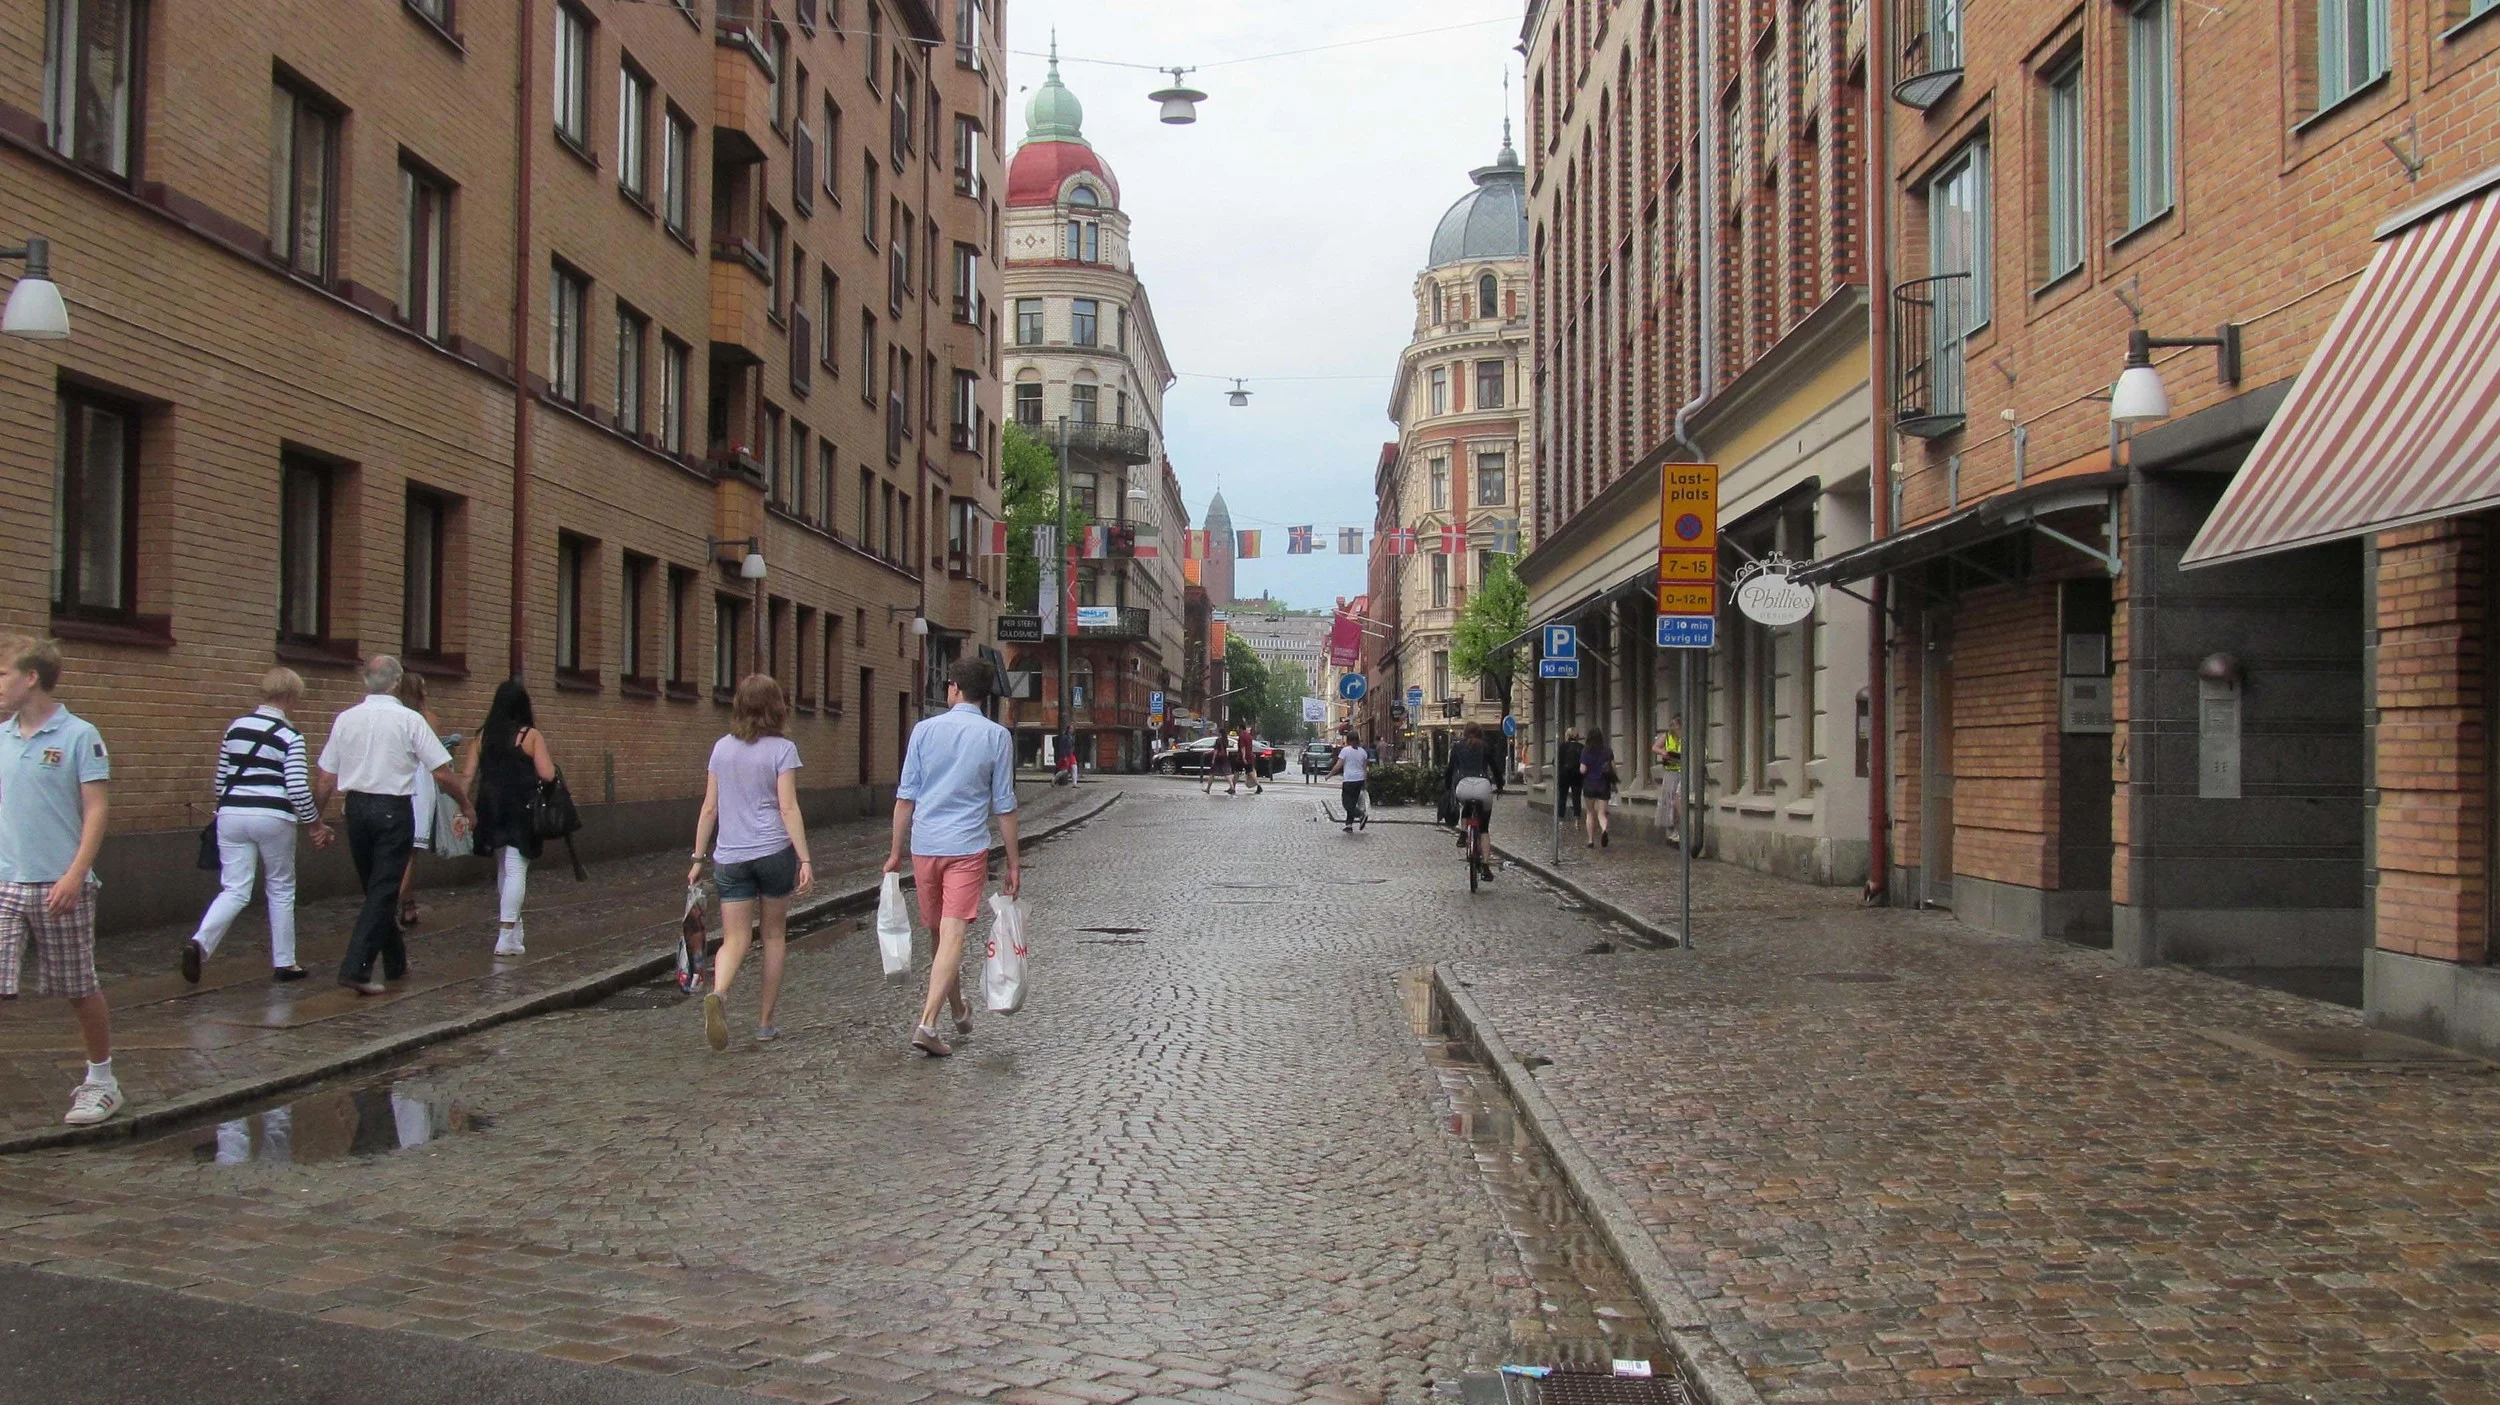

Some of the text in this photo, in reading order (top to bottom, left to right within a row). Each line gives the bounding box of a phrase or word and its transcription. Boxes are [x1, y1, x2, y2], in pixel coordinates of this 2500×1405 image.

[1671, 472, 1711, 485] Last-
[1671, 487, 1710, 503] plats
[1744, 586, 1811, 609] Phillies
[1017, 620, 1037, 628] STEEN
[1676, 621, 1687, 630] 10
[1690, 622, 1709, 630] min
[1552, 629, 1570, 655] P
[1664, 633, 1708, 644] övrig tid
[1545, 664, 1574, 673] 10 min
